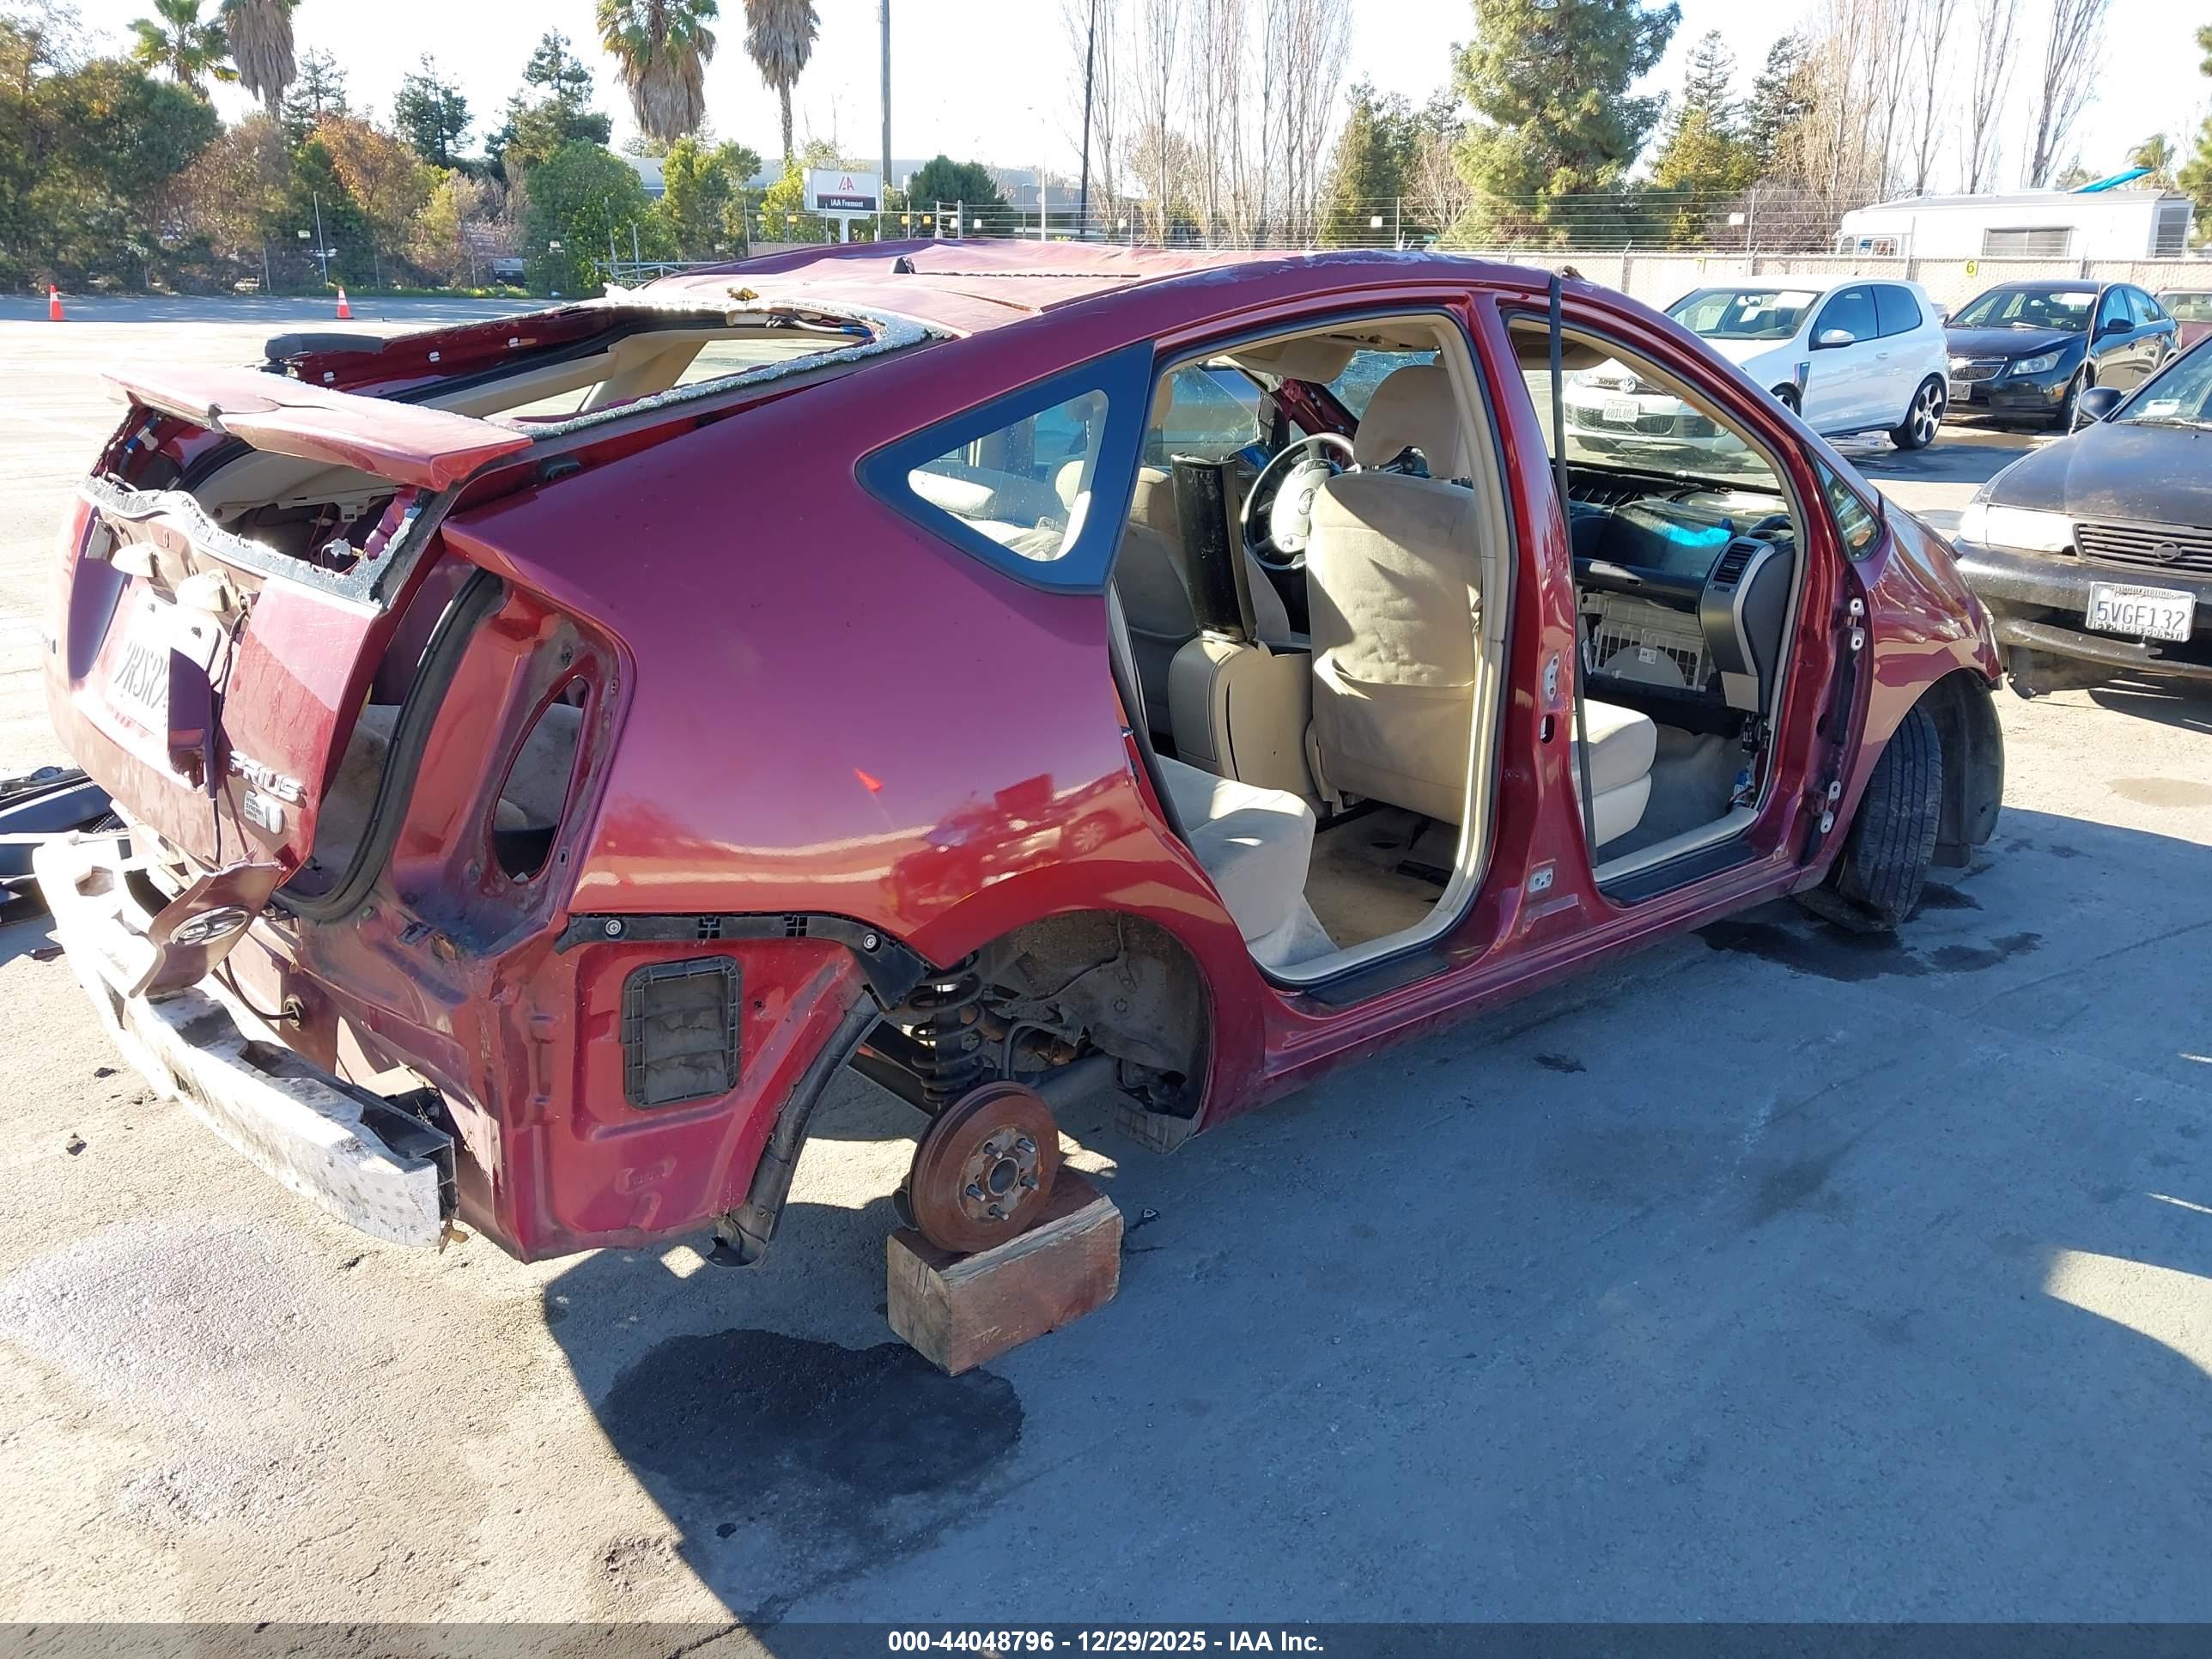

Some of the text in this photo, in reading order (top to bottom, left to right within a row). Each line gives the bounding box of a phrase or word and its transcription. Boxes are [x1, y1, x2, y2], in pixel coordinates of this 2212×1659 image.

[830, 198, 864, 208] IAA Fremont
[1966, 260, 1974, 273] 6
[2097, 600, 2185, 631] 5VGE132
[229, 750, 302, 802] PRIUS
